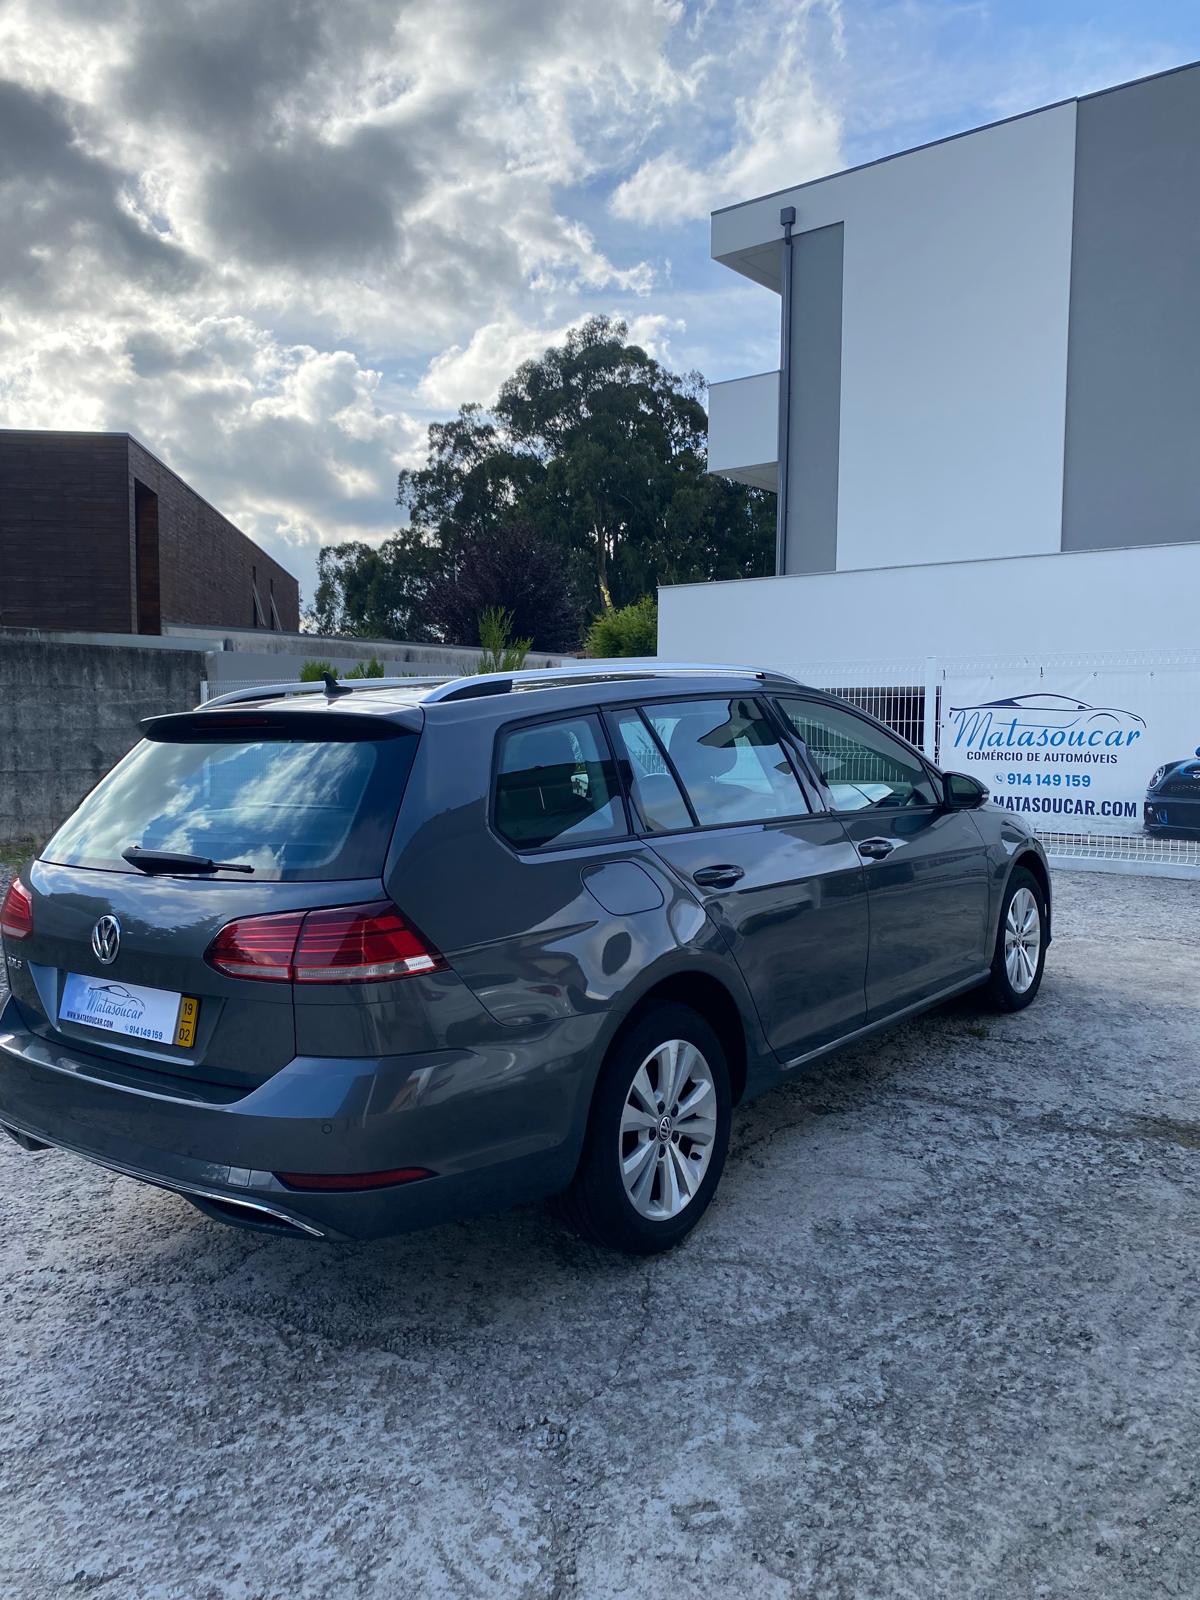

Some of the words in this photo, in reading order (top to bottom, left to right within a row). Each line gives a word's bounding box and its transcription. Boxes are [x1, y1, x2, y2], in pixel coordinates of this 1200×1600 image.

[953, 710, 1141, 751] Matasoucar
[966, 750, 1023, 762] COMÉRCIO
[1026, 752, 1041, 763] DE
[1043, 751, 1118, 764] AUTOMÓVEIS
[1007, 773, 1032, 786] 914
[1036, 773, 1062, 787] 149
[1065, 774, 1091, 788] 159
[86, 989, 144, 1020] Matasoucar
[184, 1002, 193, 1016] 19
[66, 1010, 114, 1029] WWW.MATASOUCAR.COM
[129, 1025, 140, 1036] 914
[140, 1027, 151, 1038] 149
[151, 1030, 163, 1040] 159
[179, 1028, 190, 1042] 02
